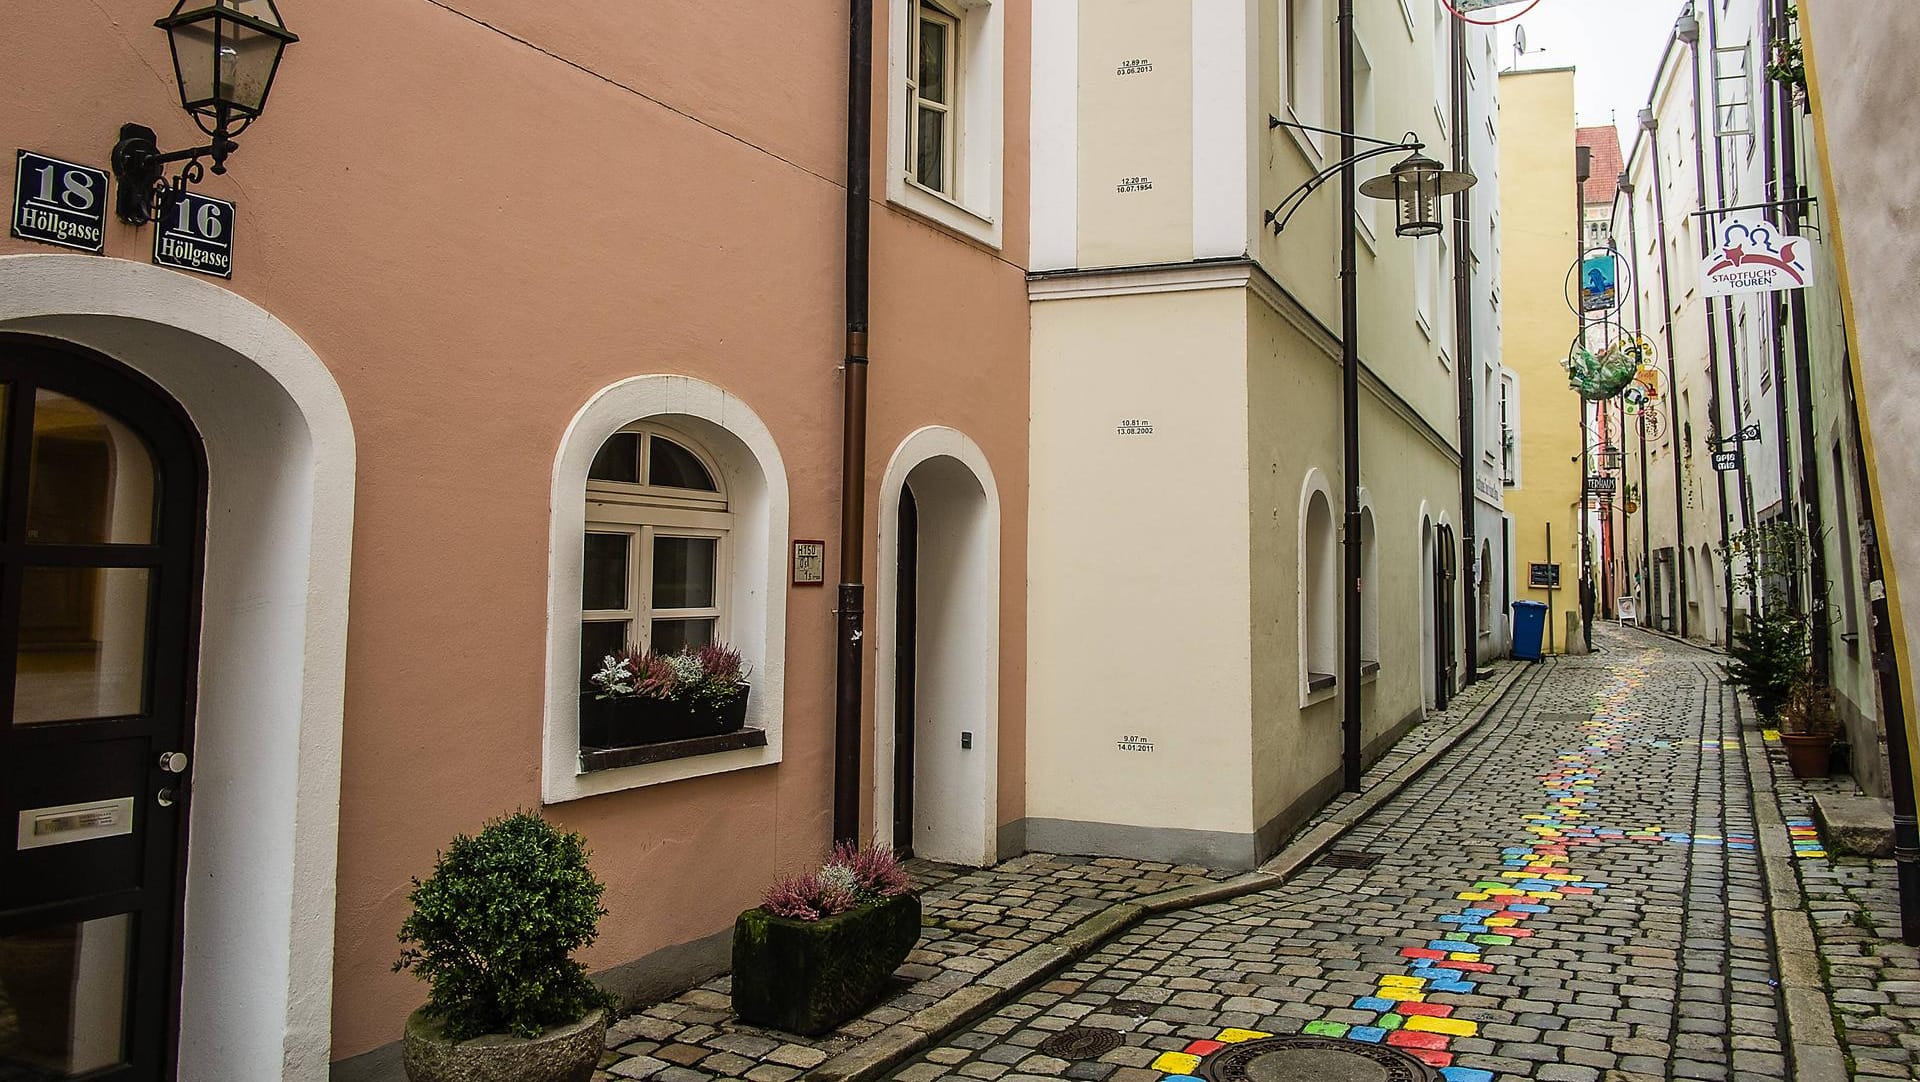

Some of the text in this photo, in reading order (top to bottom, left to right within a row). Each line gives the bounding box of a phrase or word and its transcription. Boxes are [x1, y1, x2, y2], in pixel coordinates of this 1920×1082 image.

[33, 165, 94, 210] 18
[20, 207, 100, 242] Höllgasse
[173, 198, 222, 239] 16
[161, 237, 229, 268] Höllgasse
[1712, 268, 1777, 283] STADTFUCHS
[1730, 277, 1772, 288] TOUREN
[798, 544, 816, 555] H150
[1118, 744, 1154, 752] 14.01.2011
